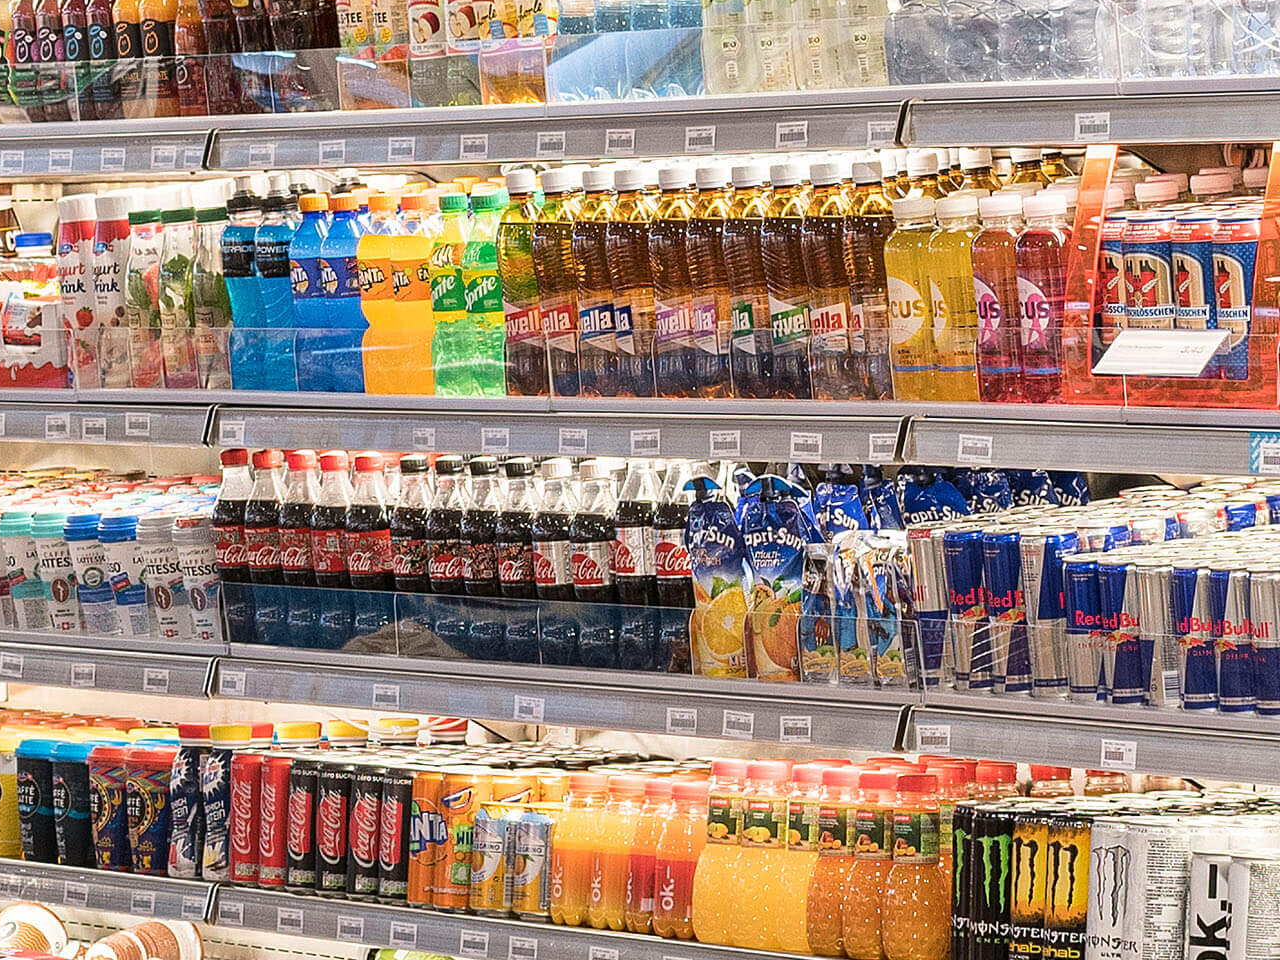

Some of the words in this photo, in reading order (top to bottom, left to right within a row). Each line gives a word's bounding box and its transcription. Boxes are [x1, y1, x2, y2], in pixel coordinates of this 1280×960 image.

[257, 245, 289, 254] POWER
[465, 275, 498, 310] Sprite
[890, 300, 925, 319] CUS
[976, 301, 1001, 319] US
[232, 778, 252, 854] Coca-Cola
[320, 786, 341, 865] Coca-Cola
[353, 789, 378, 868] Coca-Cola
